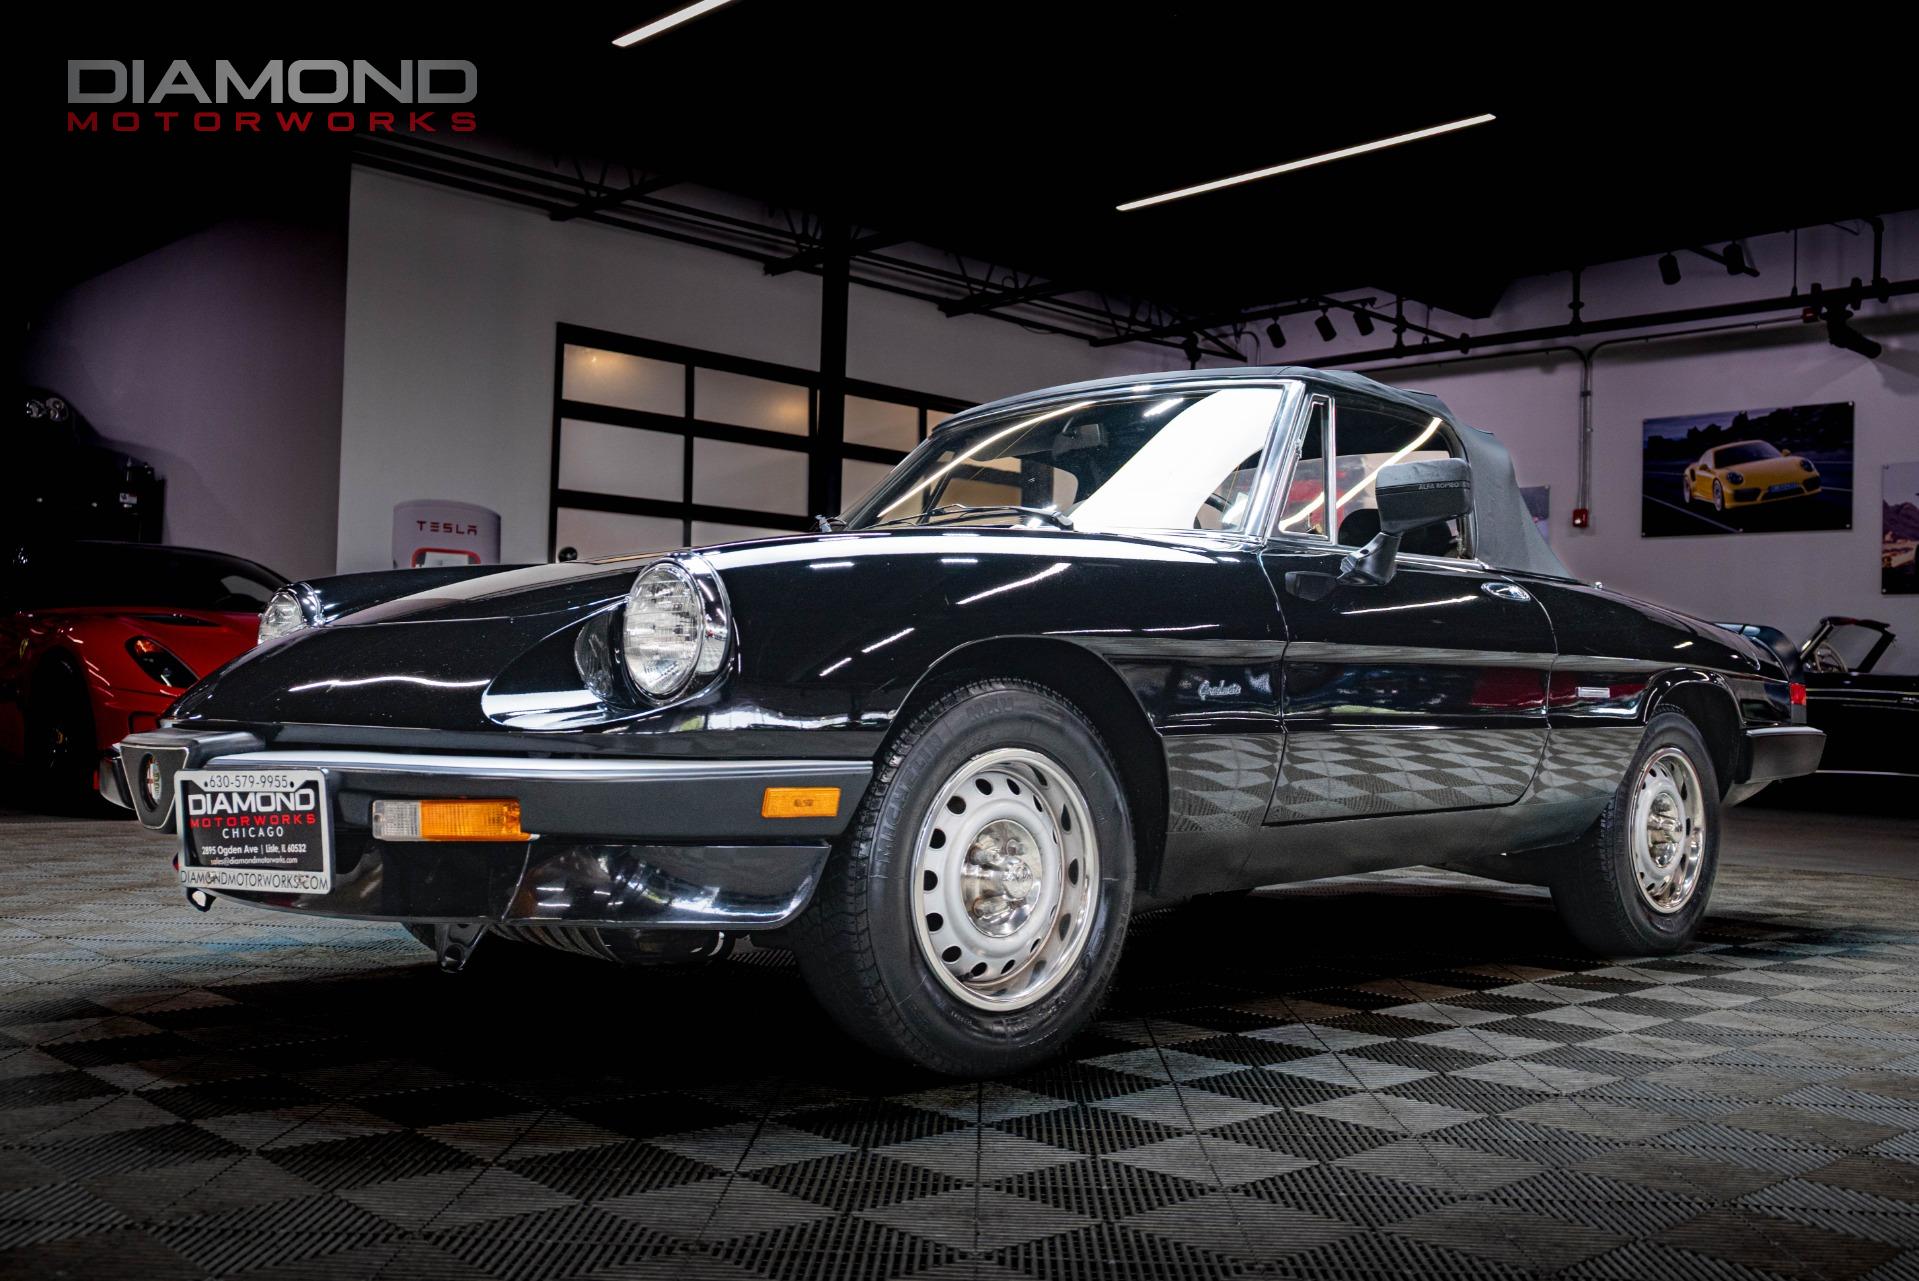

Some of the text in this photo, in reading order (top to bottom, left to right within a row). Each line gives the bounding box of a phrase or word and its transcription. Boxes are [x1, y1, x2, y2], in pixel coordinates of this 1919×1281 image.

[416, 520, 478, 536] TESLA
[209, 775, 288, 788] 630-579-9955
[188, 789, 315, 815] DIAMOND
[189, 814, 316, 828] MOTORWORKS
[222, 826, 284, 839] CHICAGO
[217, 845, 242, 857] Ogden
[244, 845, 258, 853] Ave
[287, 844, 306, 852] 60532
